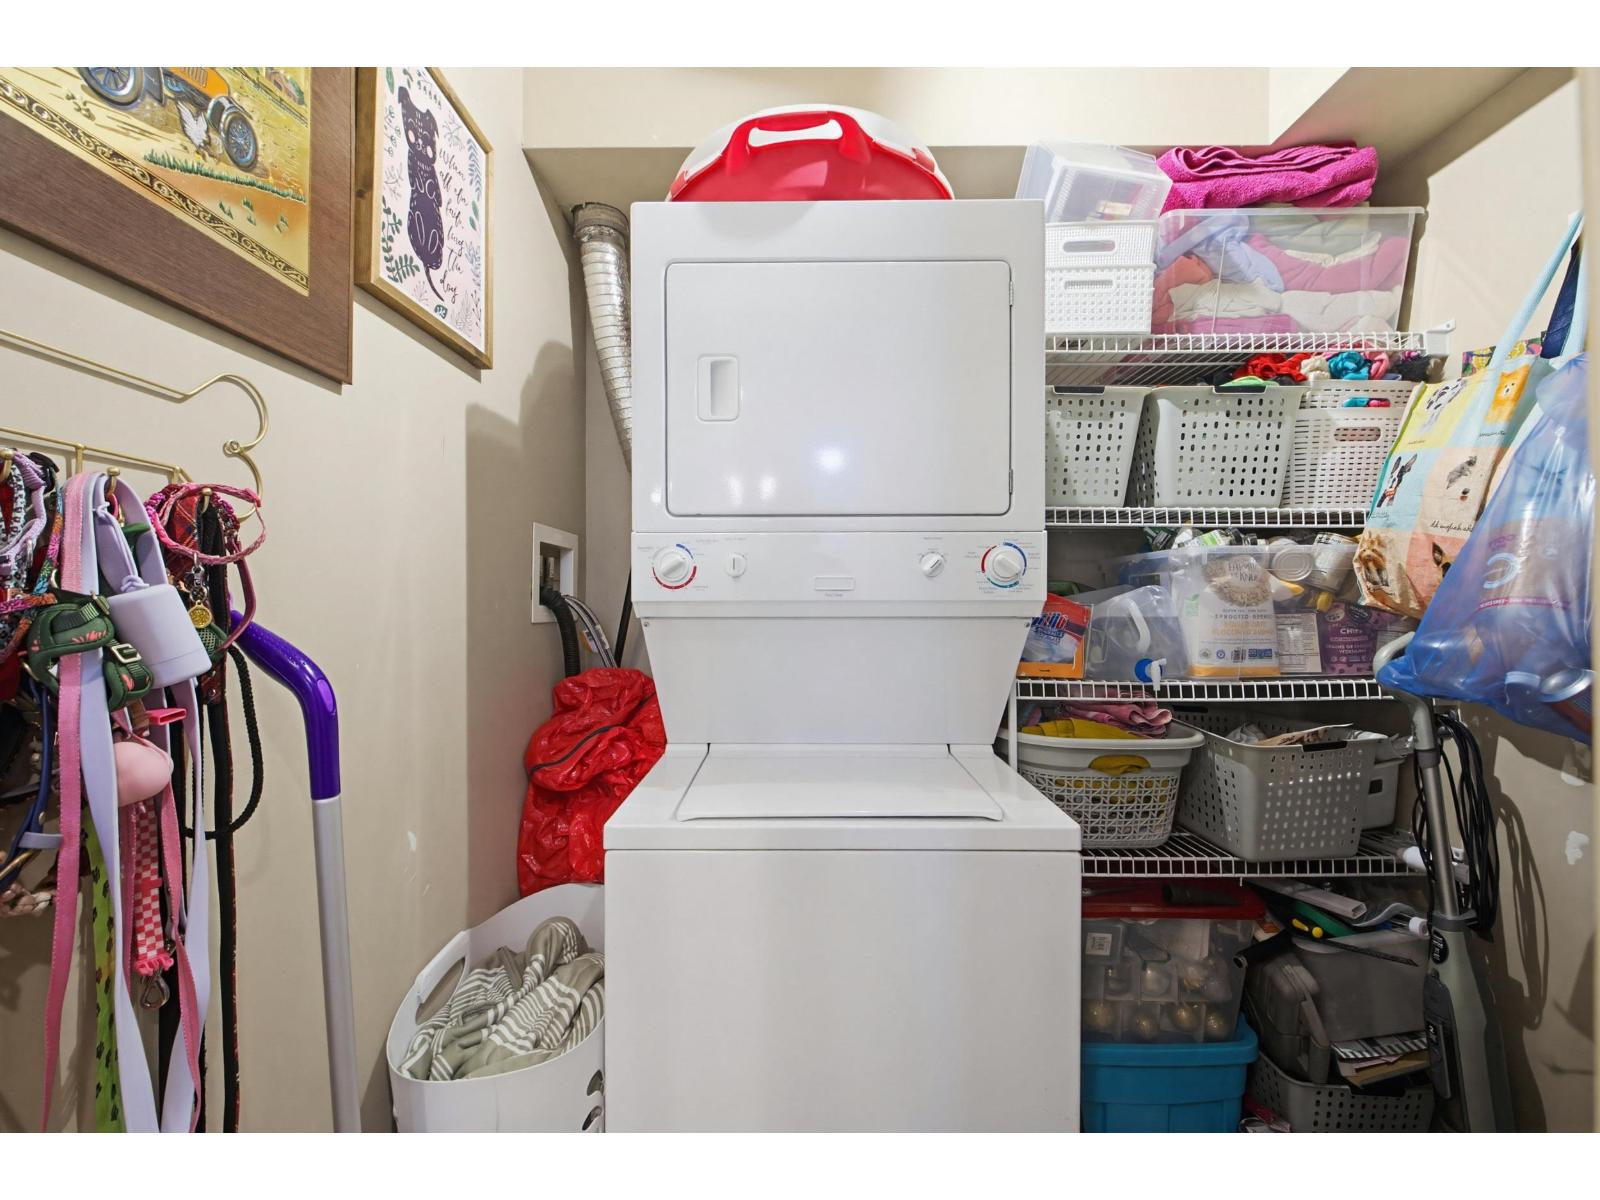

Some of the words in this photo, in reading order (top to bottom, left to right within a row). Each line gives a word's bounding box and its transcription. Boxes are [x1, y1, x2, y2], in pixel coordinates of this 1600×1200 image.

[438, 149, 466, 181] When
[439, 170, 452, 193] all
[447, 225, 465, 258] hug
[439, 270, 459, 304] dog
